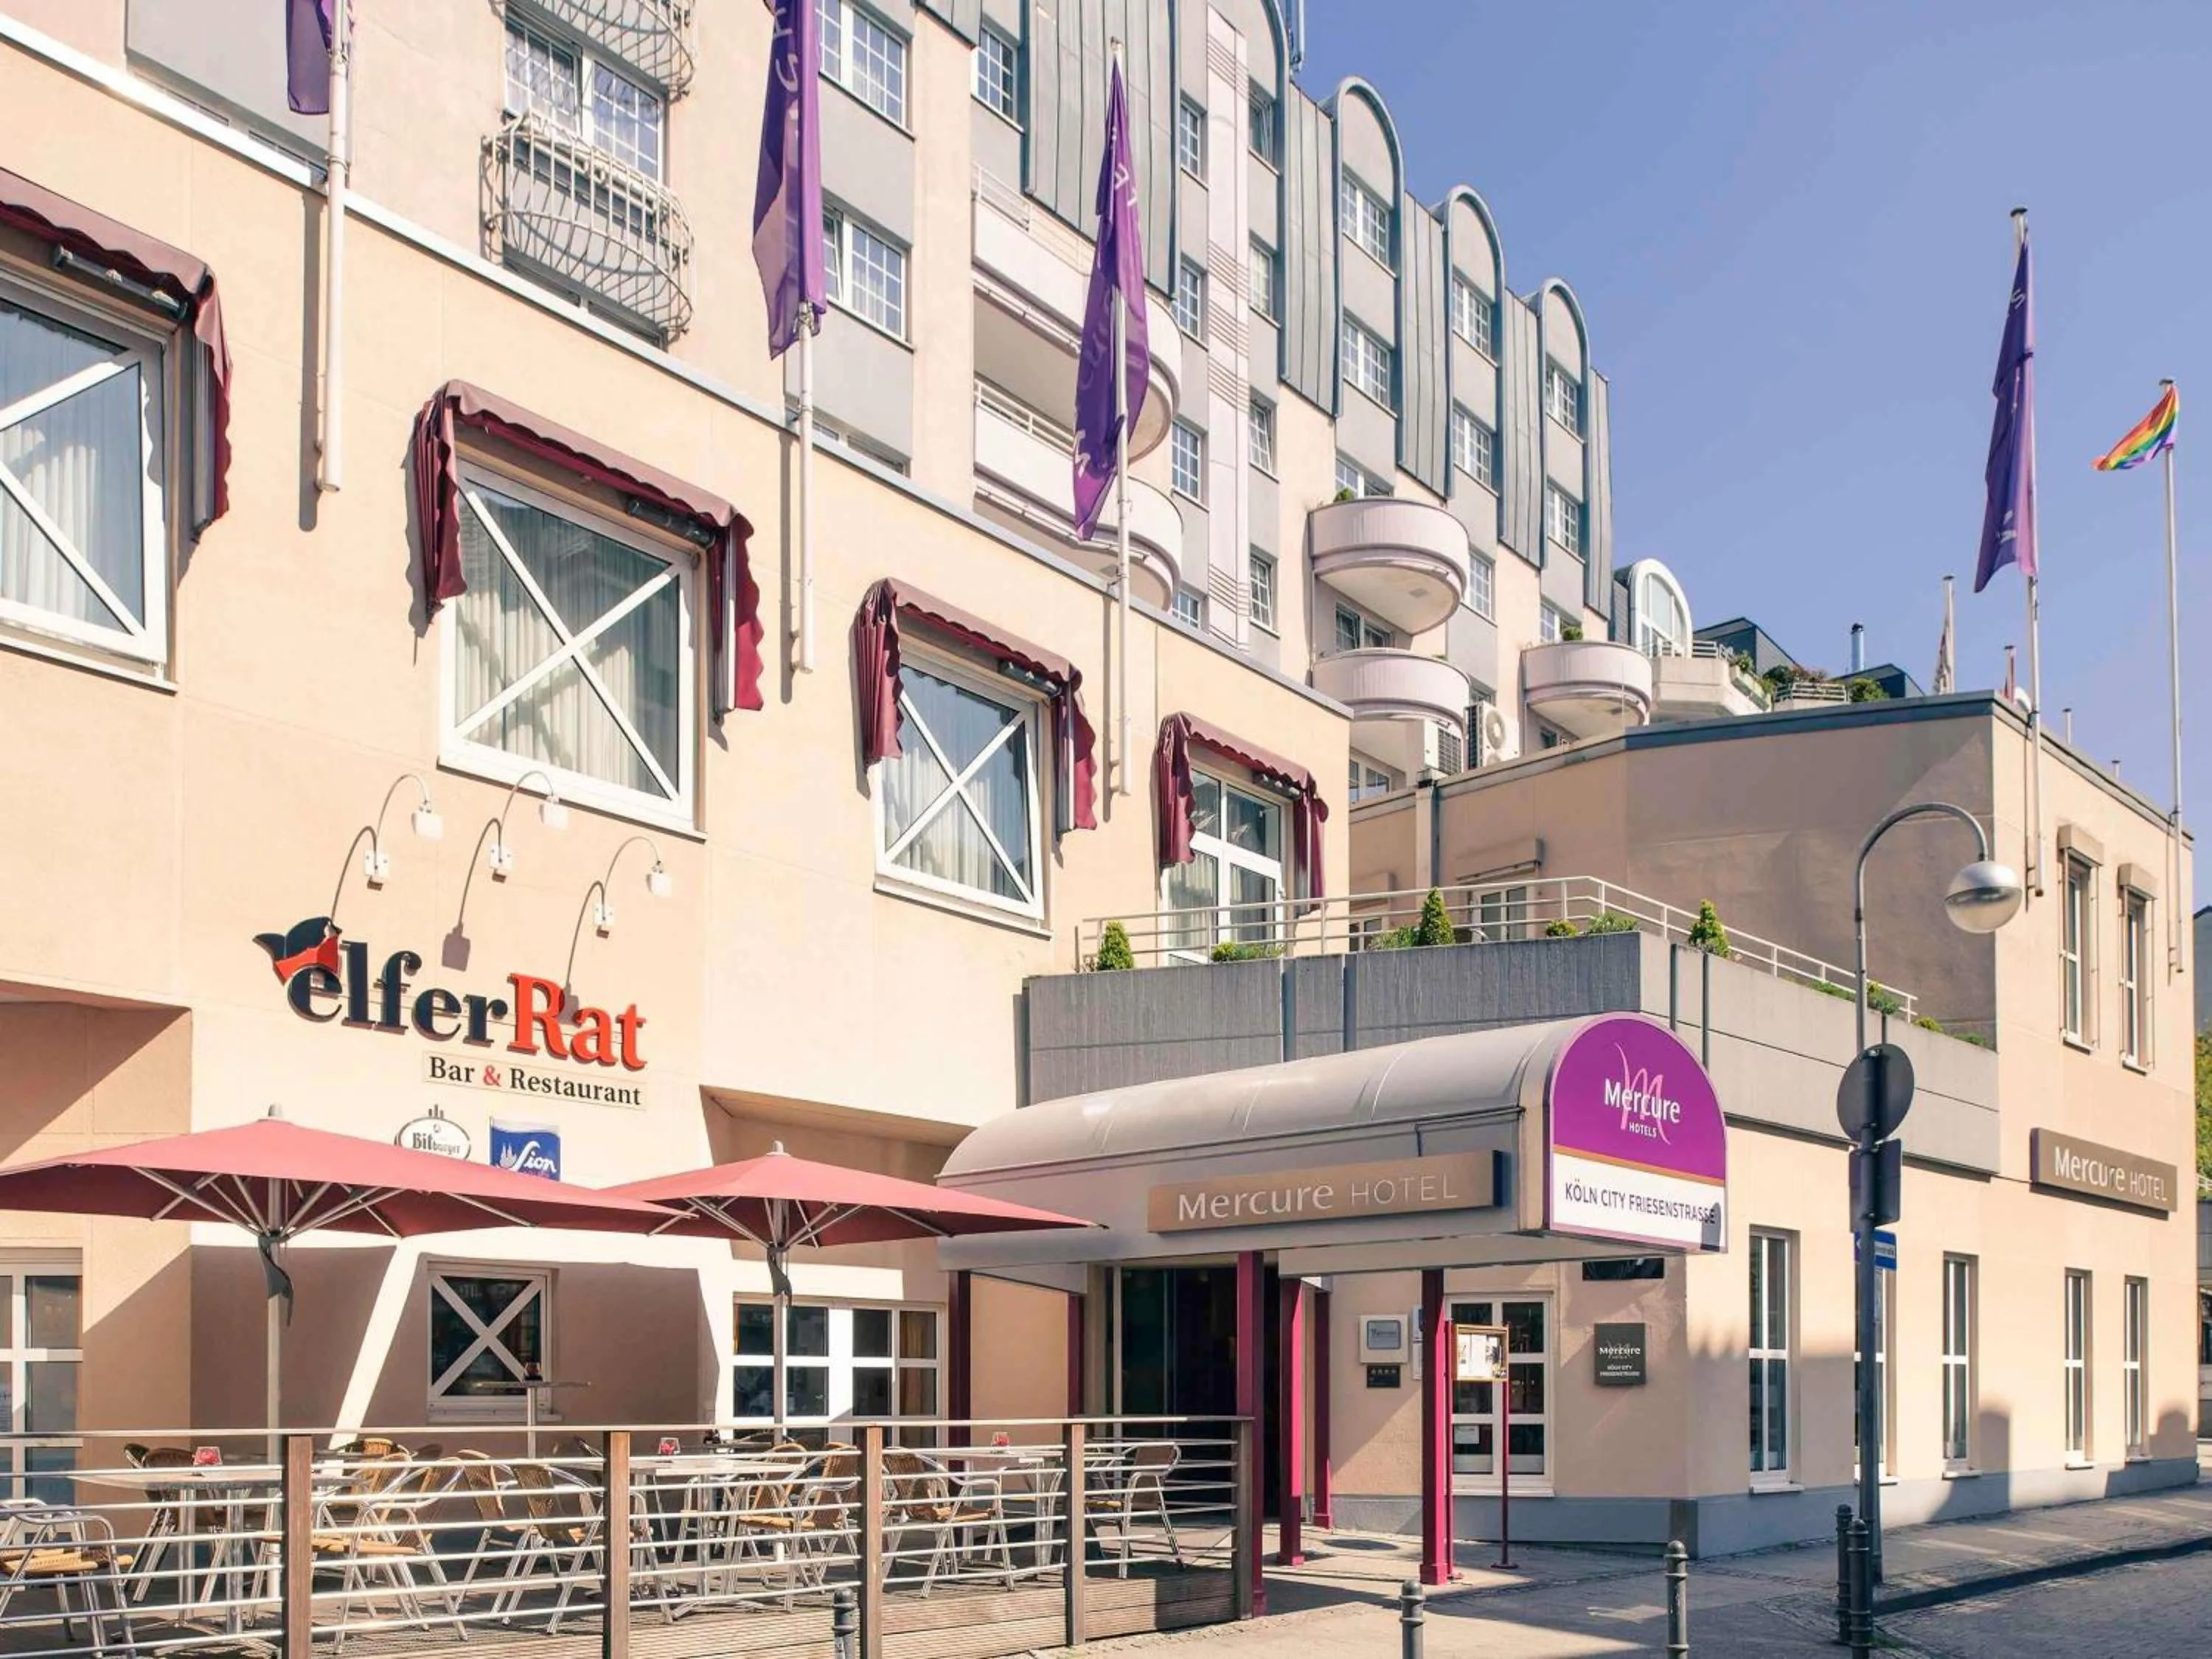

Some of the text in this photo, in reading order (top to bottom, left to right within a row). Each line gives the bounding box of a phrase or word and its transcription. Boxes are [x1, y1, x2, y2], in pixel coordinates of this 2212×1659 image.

[287, 939, 647, 1071] elferRat
[429, 1056, 641, 1106] Bar & Restaurant
[1604, 1077, 1680, 1124] Mercure
[1629, 1121, 1657, 1138] HOTELS
[2054, 1145, 2168, 1201] Mercure HOTEL
[1178, 1174, 1458, 1222] Mercure HOTEL
[1565, 1178, 1716, 1225] KÖLN CITY FRIESENSTRASSE
